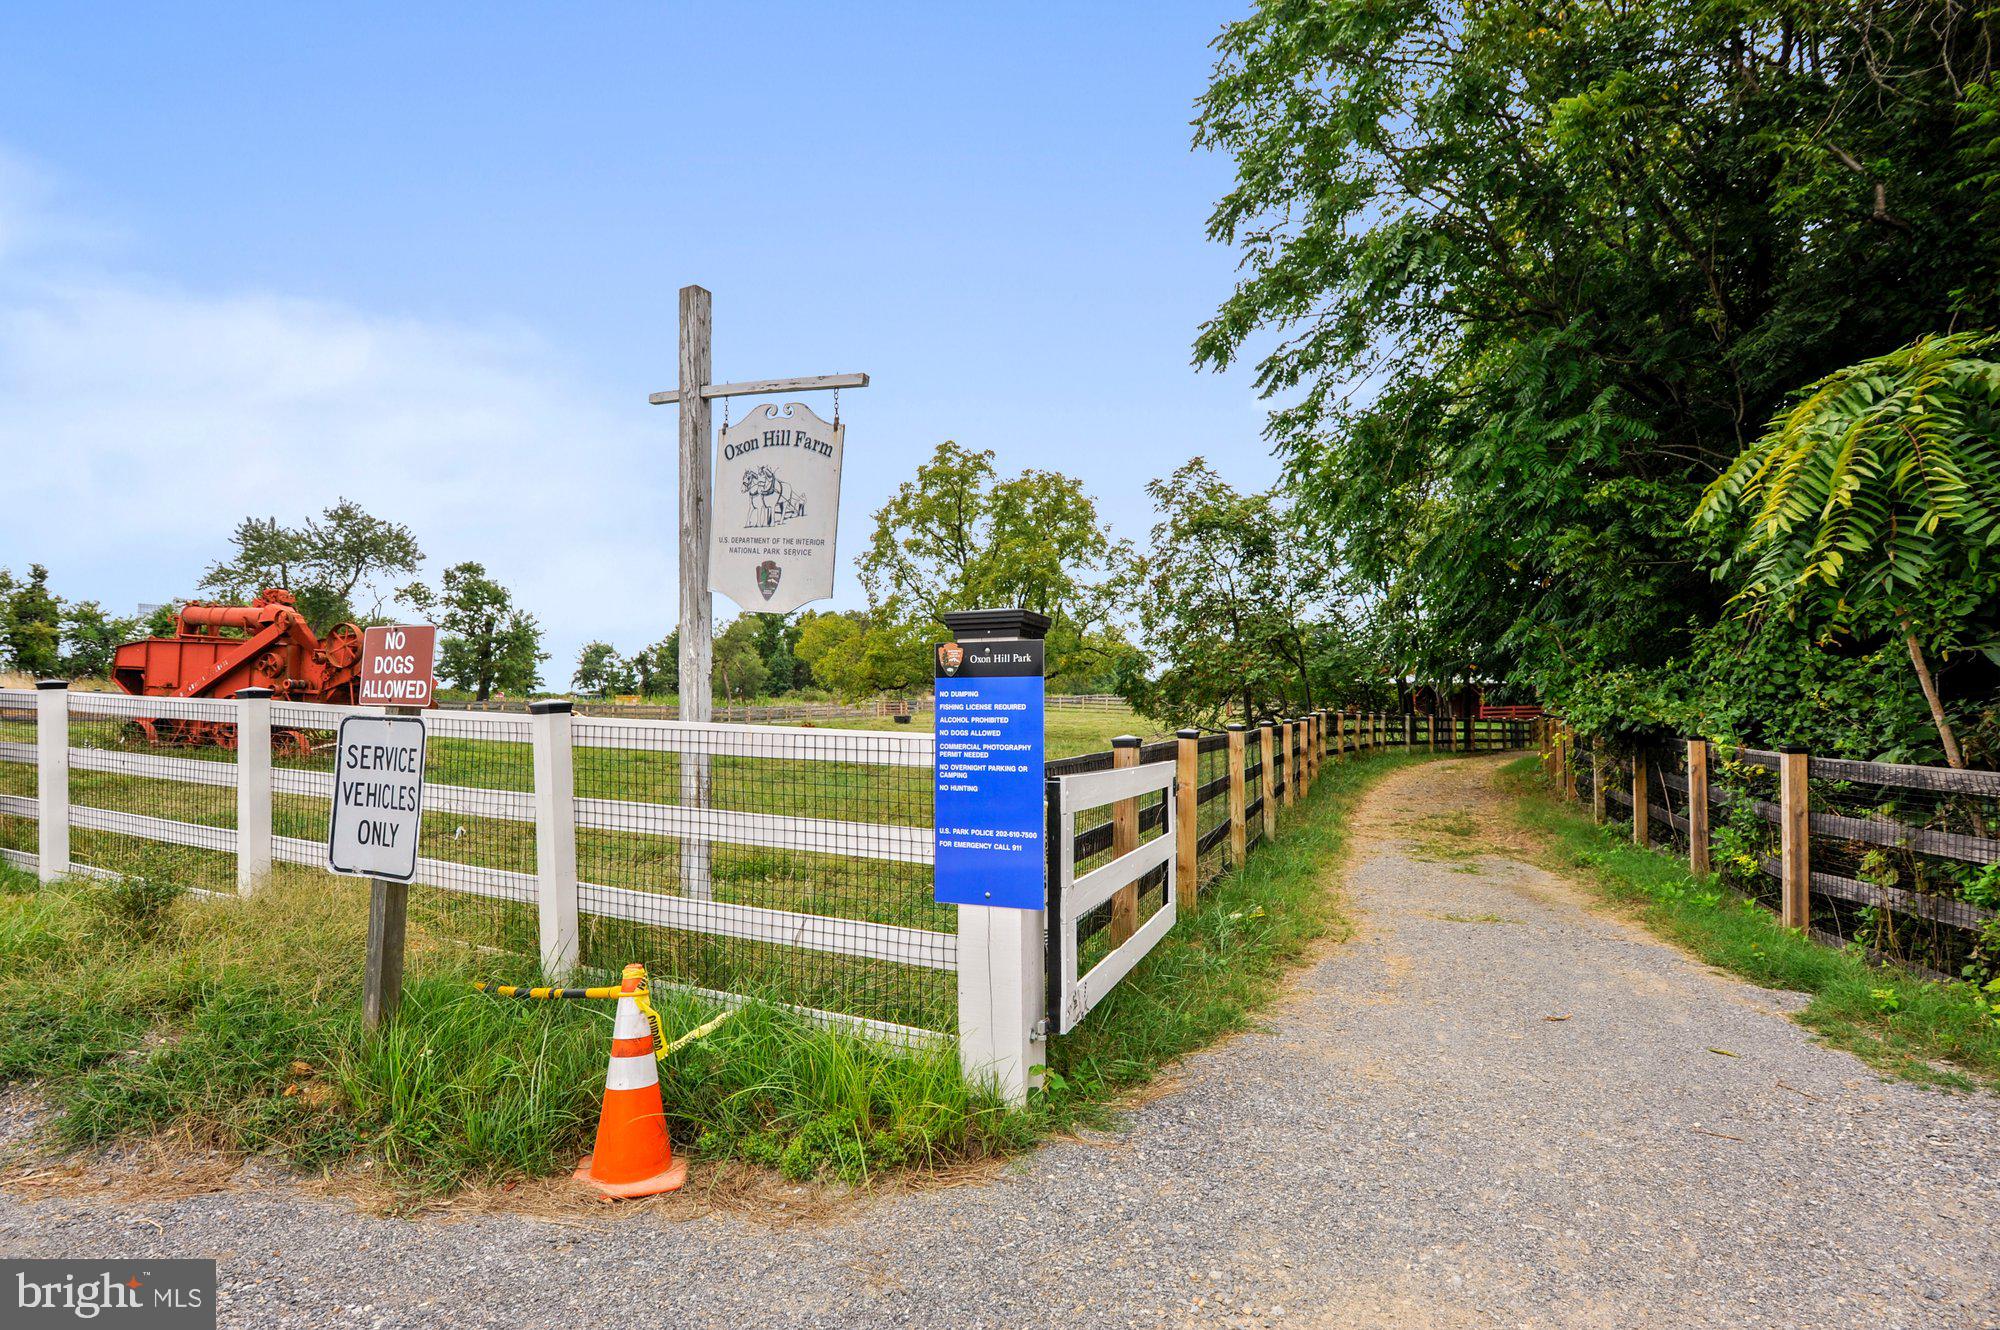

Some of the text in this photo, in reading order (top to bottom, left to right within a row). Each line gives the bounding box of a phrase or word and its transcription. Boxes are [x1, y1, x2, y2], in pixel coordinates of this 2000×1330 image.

[724, 429, 834, 461] Oxon Hill Farm
[718, 536, 729, 544] U.S.
[730, 536, 770, 544] DEPARTMENT
[782, 537, 794, 545] THE
[795, 538, 825, 546] INTERIOR
[728, 547, 812, 557] NATIONAL PARK SERVICE
[384, 631, 406, 650] NO
[969, 653, 1032, 664] Oxon Hill Park
[373, 655, 415, 675] DOGS
[361, 679, 428, 700] ALLOWED
[939, 703, 1027, 711] FISHING LICENSE REQUIRED
[939, 716, 1009, 724] ALCOHOL PROHIBITED
[970, 729, 1001, 737] ALLOWED
[939, 743, 981, 751] COMMERCIAL
[346, 744, 417, 774] SERVICE
[939, 771, 968, 779] CAMPING
[342, 781, 416, 812] VEHICLES
[357, 819, 400, 848] ONLY
[970, 829, 994, 837] POLICE
[953, 841, 992, 849] EMERGENCY
[993, 843, 1011, 851] CALL
